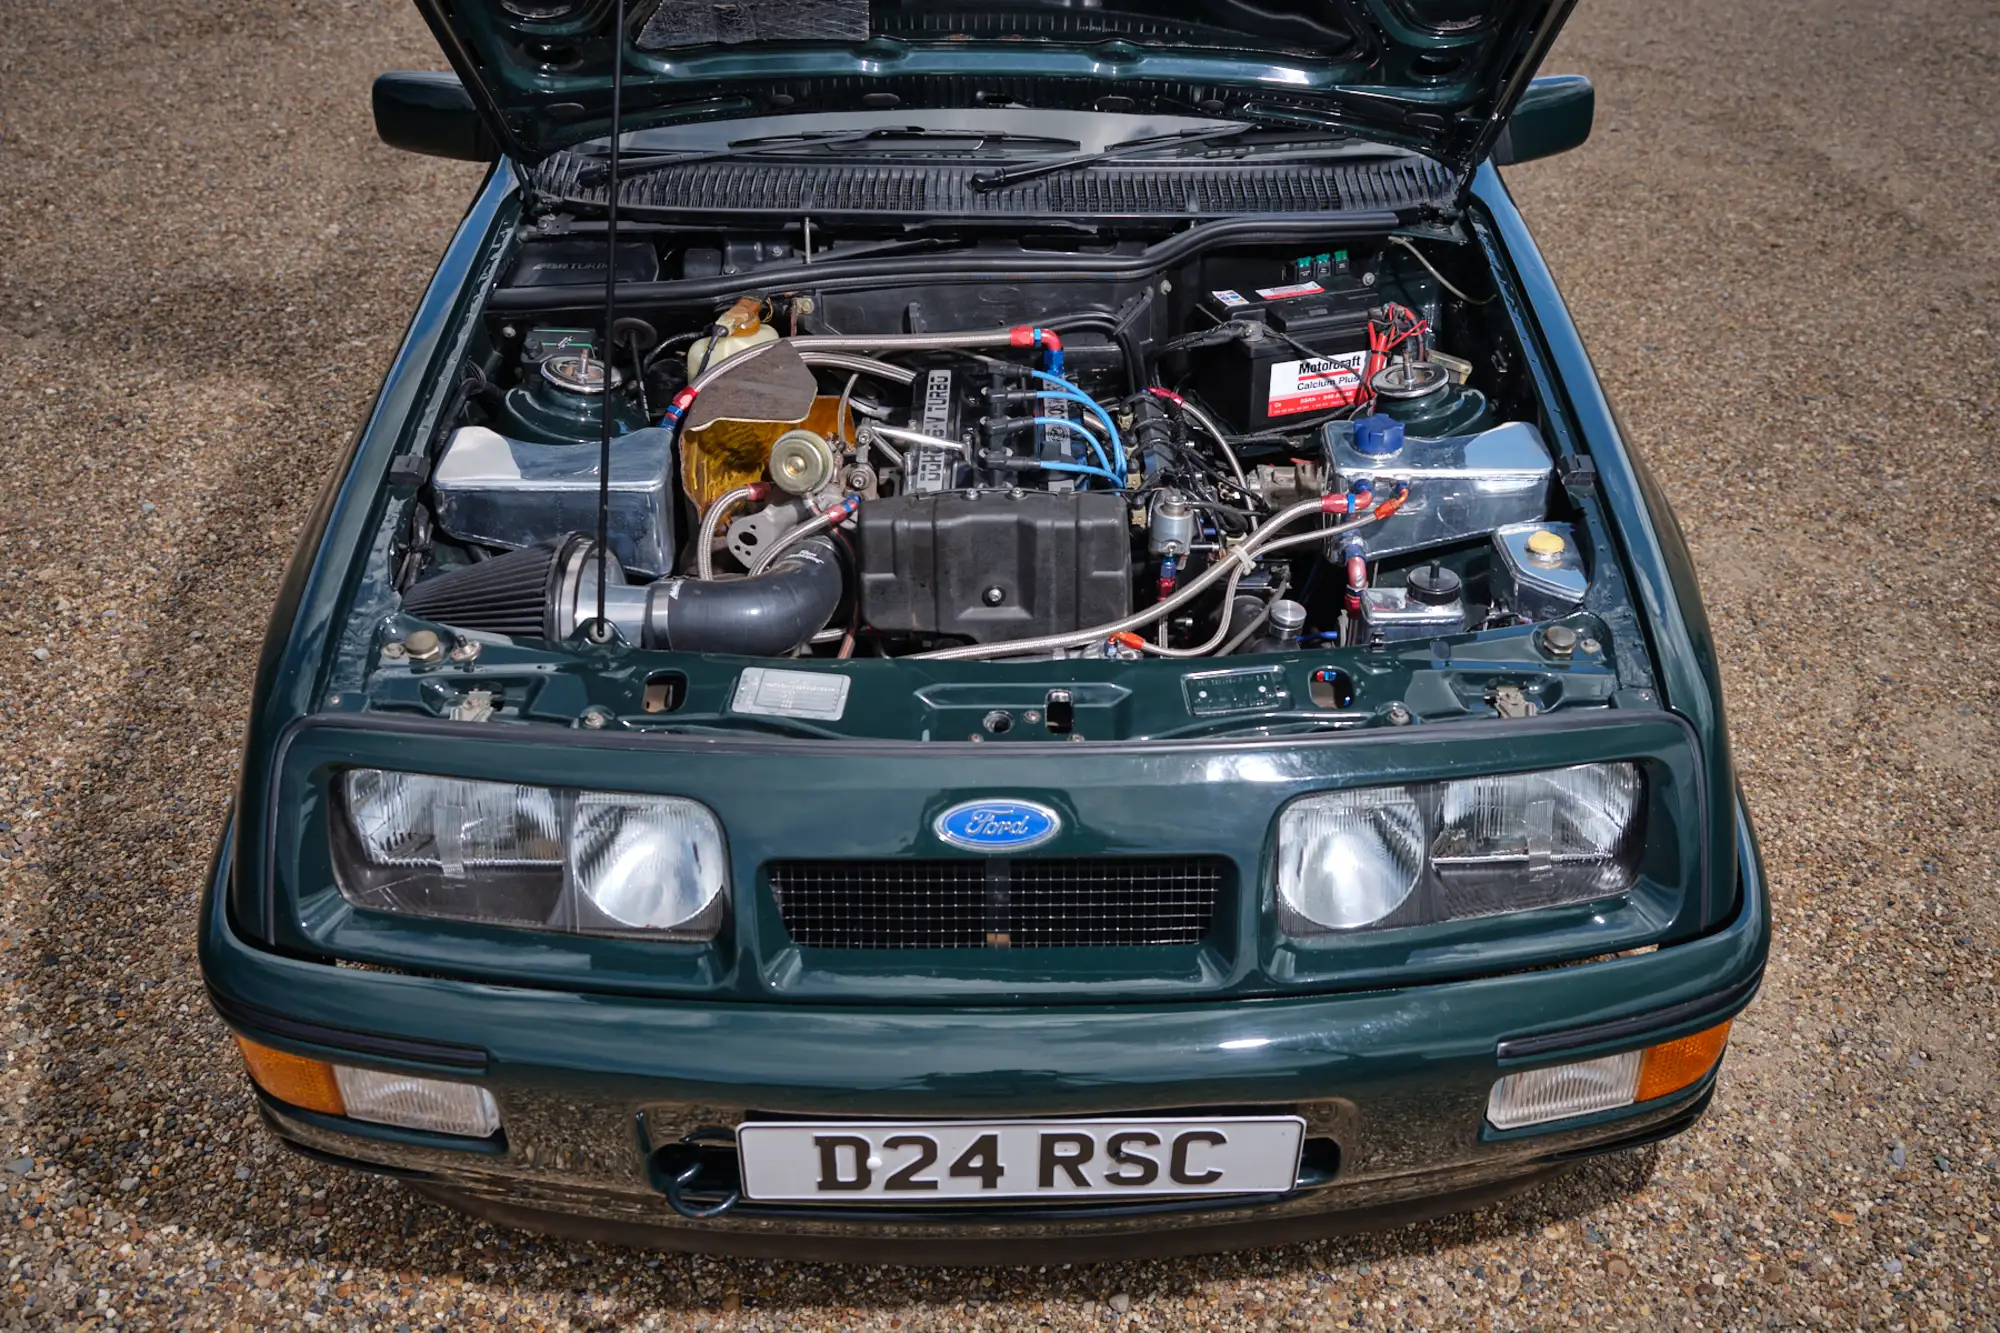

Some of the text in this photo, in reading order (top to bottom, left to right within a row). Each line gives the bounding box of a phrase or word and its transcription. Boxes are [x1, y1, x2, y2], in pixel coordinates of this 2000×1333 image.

[926, 375, 949, 412] TURBO
[1297, 375, 1359, 391] Calcium Plus
[964, 809, 1030, 835] Ford
[813, 1130, 1227, 1191] D24 RSC
